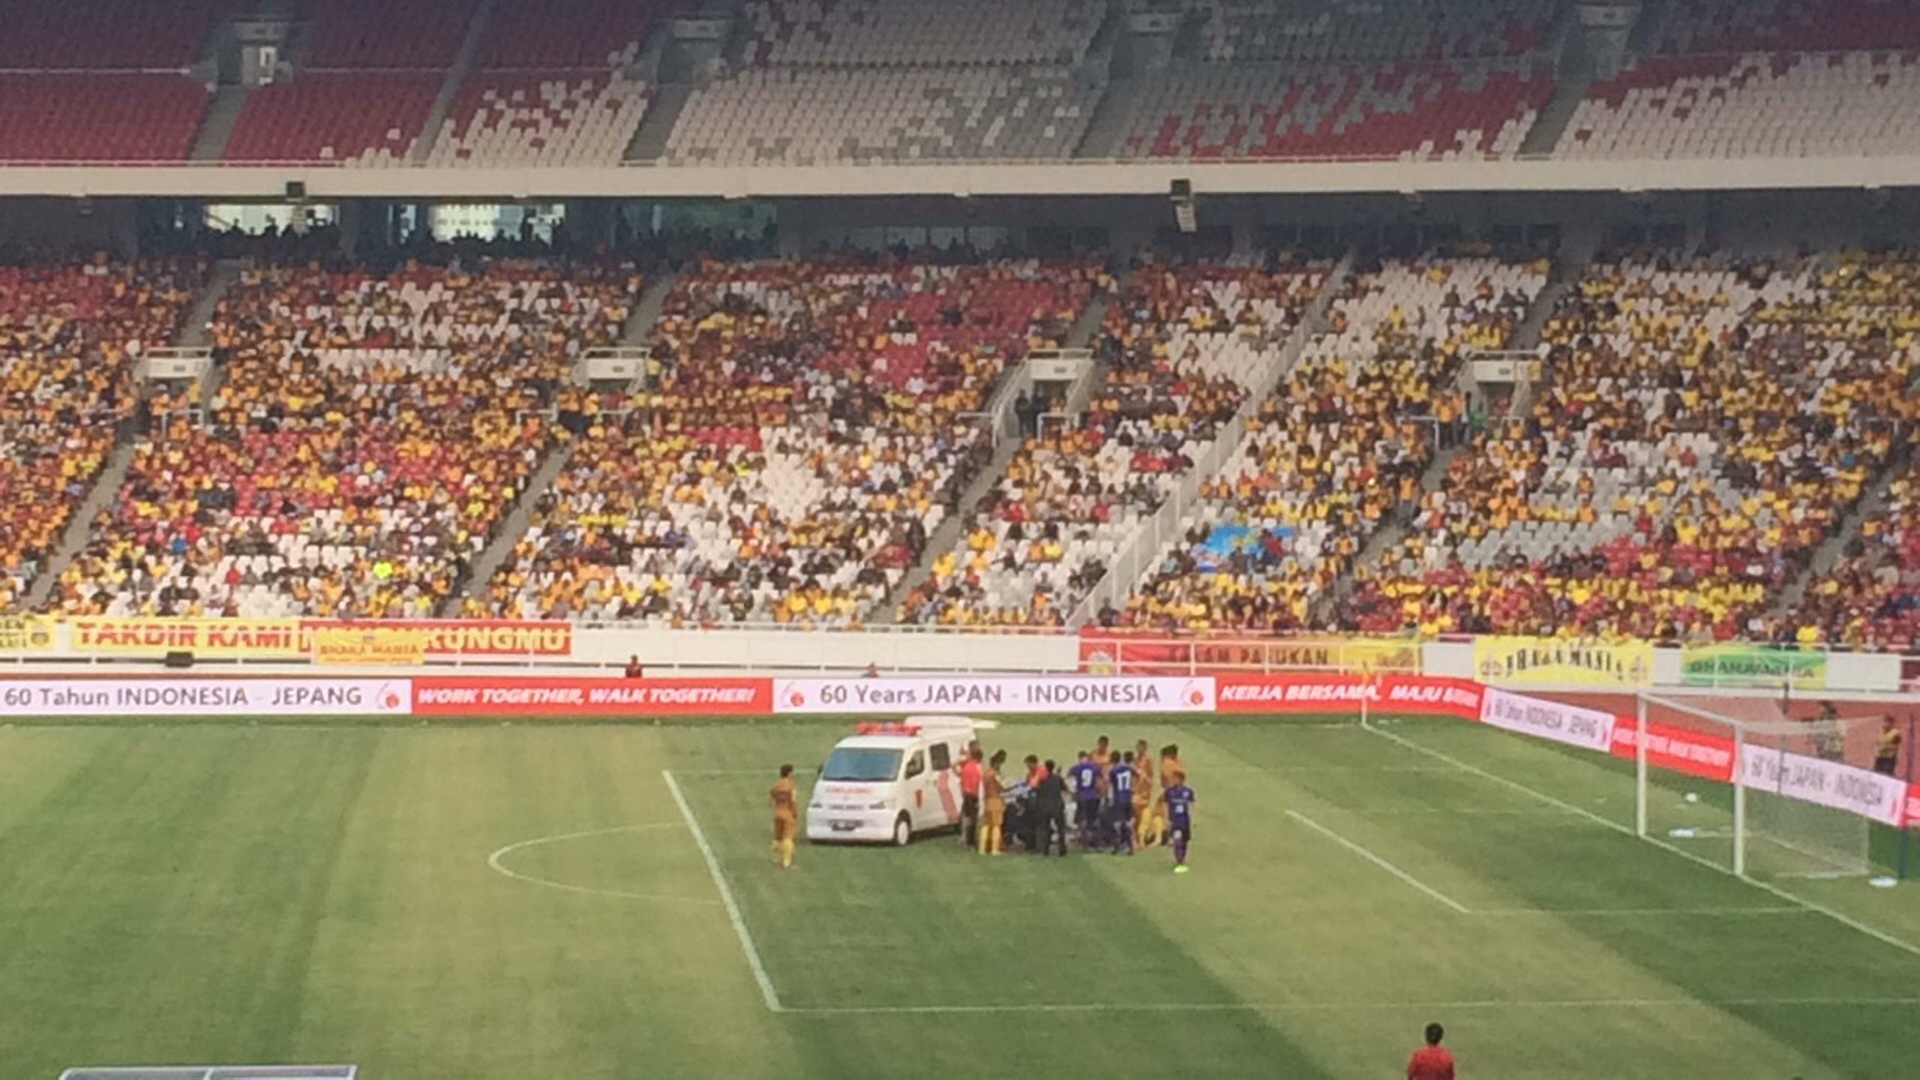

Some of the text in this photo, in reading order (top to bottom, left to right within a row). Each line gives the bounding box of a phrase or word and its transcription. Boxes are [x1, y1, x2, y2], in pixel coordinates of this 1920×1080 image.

[77, 622, 292, 648] TAKDIR KAMI
[4, 687, 33, 706] 60
[40, 687, 109, 706] Tahun
[116, 687, 248, 706] INDONESIA
[271, 687, 362, 706] JEPANG
[418, 689, 477, 704] WORK
[589, 688, 647, 704] WALK
[820, 685, 848, 704] 60
[855, 685, 917, 704] Years
[923, 685, 1002, 704] JAPAN
[1027, 684, 1161, 704] INDONESIA
[1221, 685, 1282, 701] KERJA
[1081, 768, 1093, 787] 9
